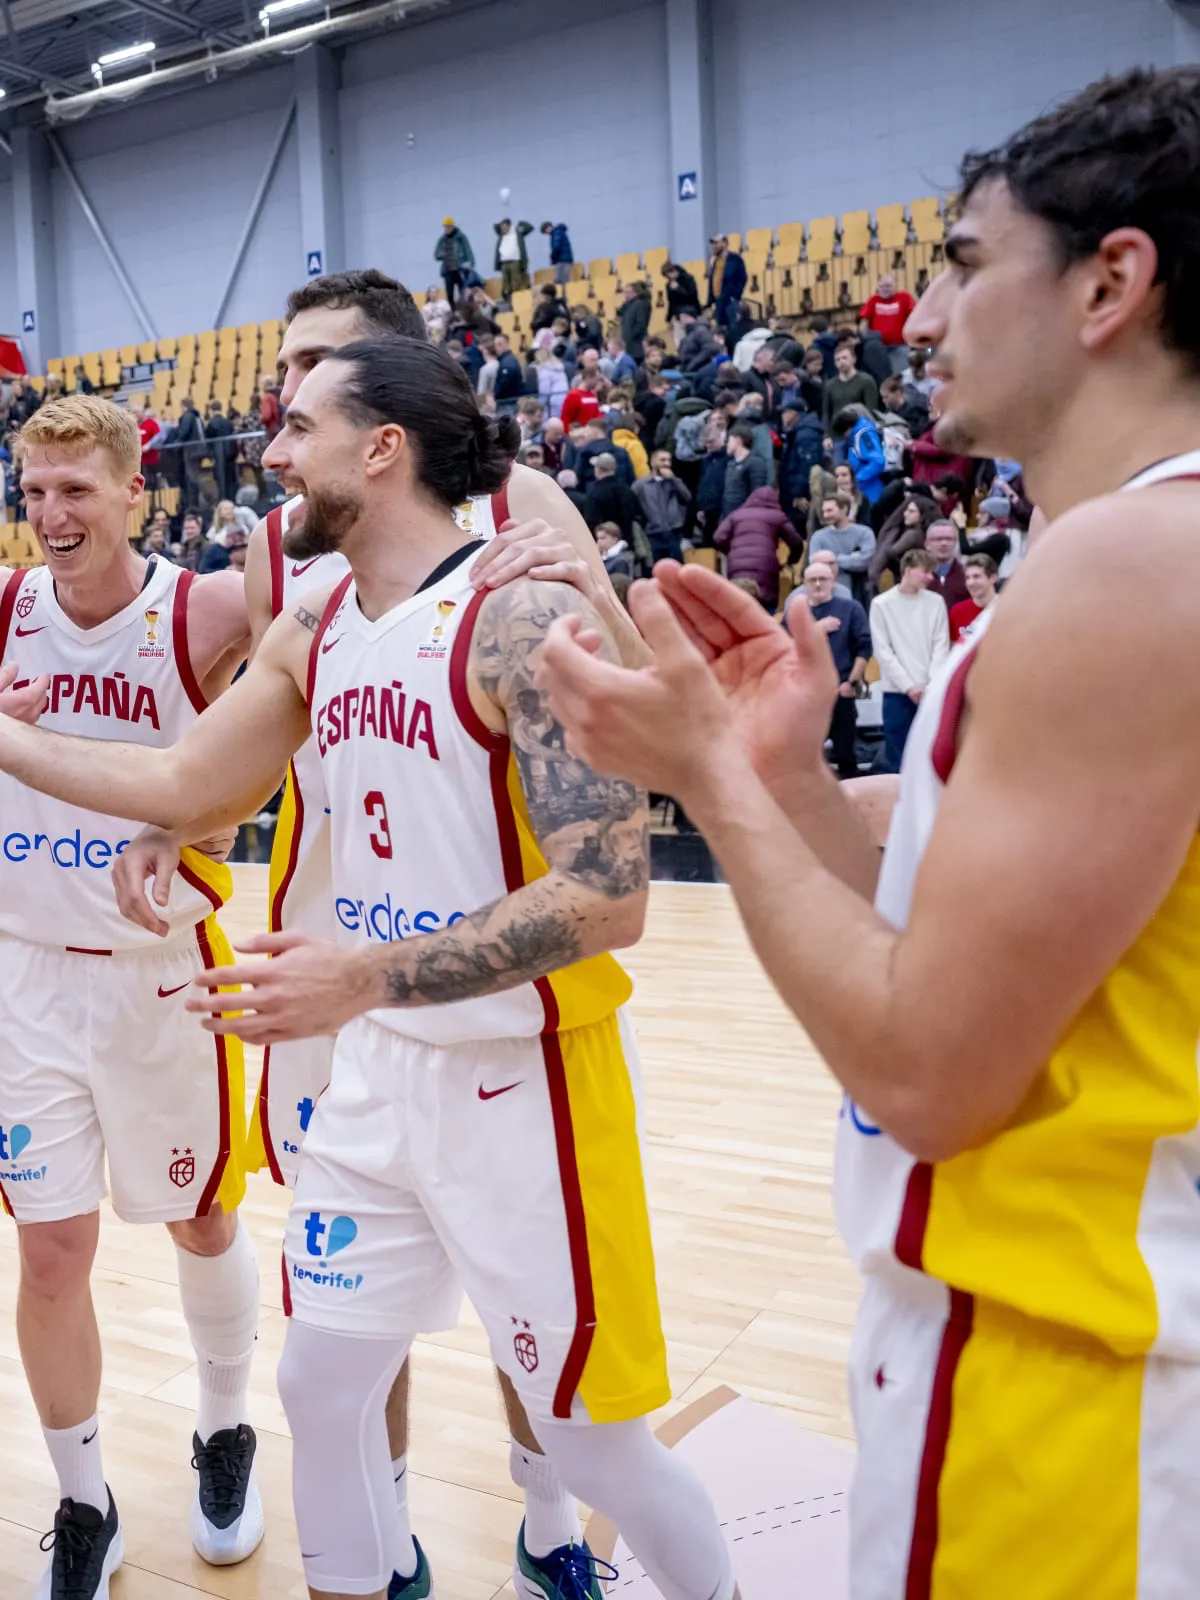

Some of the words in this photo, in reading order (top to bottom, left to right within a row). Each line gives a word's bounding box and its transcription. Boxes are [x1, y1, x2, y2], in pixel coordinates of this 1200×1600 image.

[680, 177, 695, 195] A
[310, 255, 321, 271] A
[317, 679, 441, 762] ESPAÑA
[363, 790, 393, 860] 3
